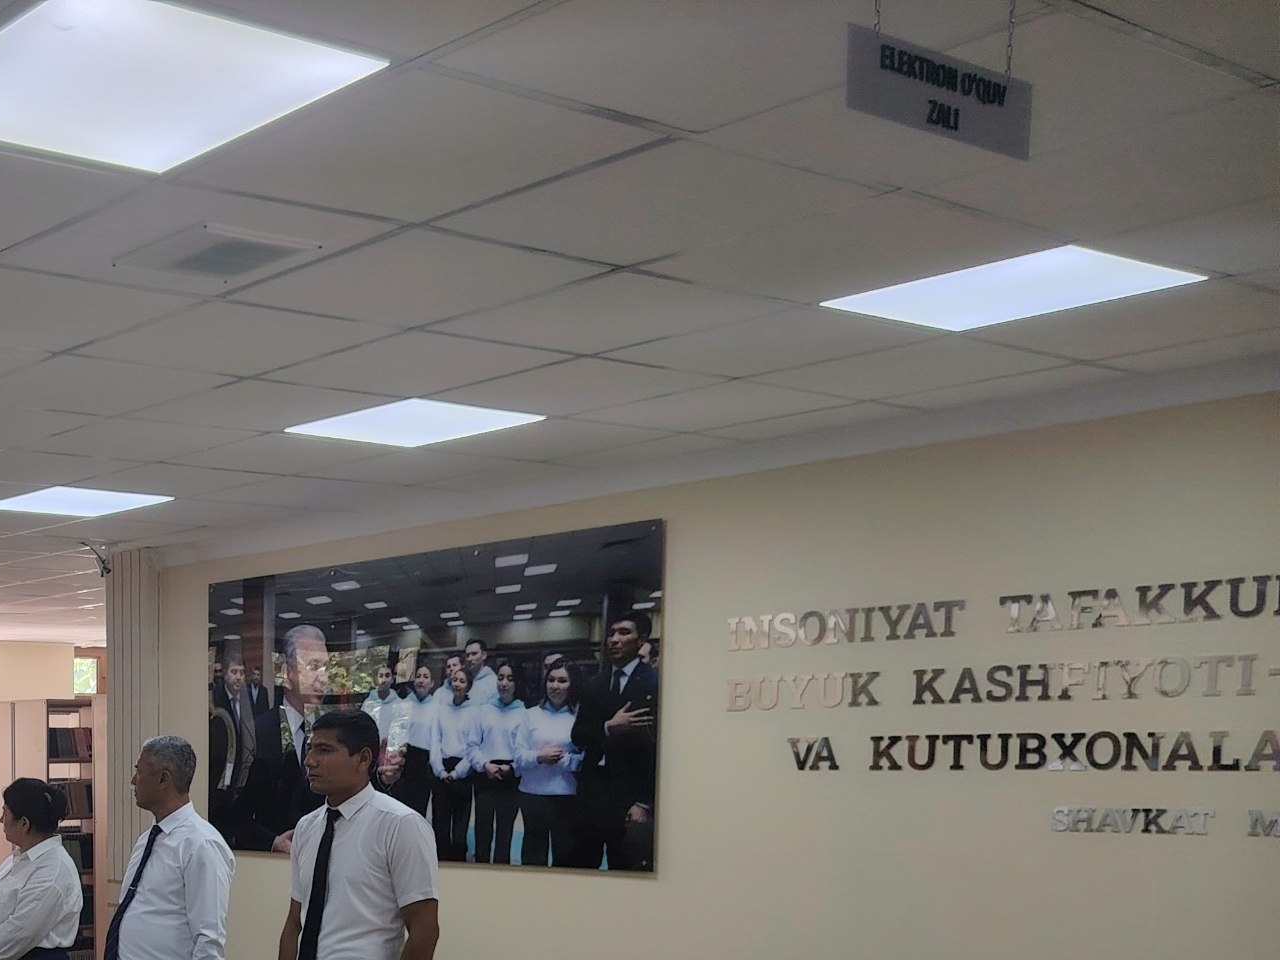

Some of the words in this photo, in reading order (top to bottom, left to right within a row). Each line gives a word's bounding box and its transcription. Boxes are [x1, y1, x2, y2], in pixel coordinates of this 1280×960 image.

[880, 44, 958, 93] ELEKTRON
[926, 99, 960, 132] ZALI
[727, 600, 966, 652] INSONIYAT
[999, 574, 1280, 634] TAFAKKU
[726, 671, 880, 712] BUYUK
[912, 654, 1258, 705] KASHFIYOTI
[787, 736, 840, 771] VA
[869, 730, 1280, 772] KUTUBXONALA
[1050, 806, 1215, 836] SHAVKAT
